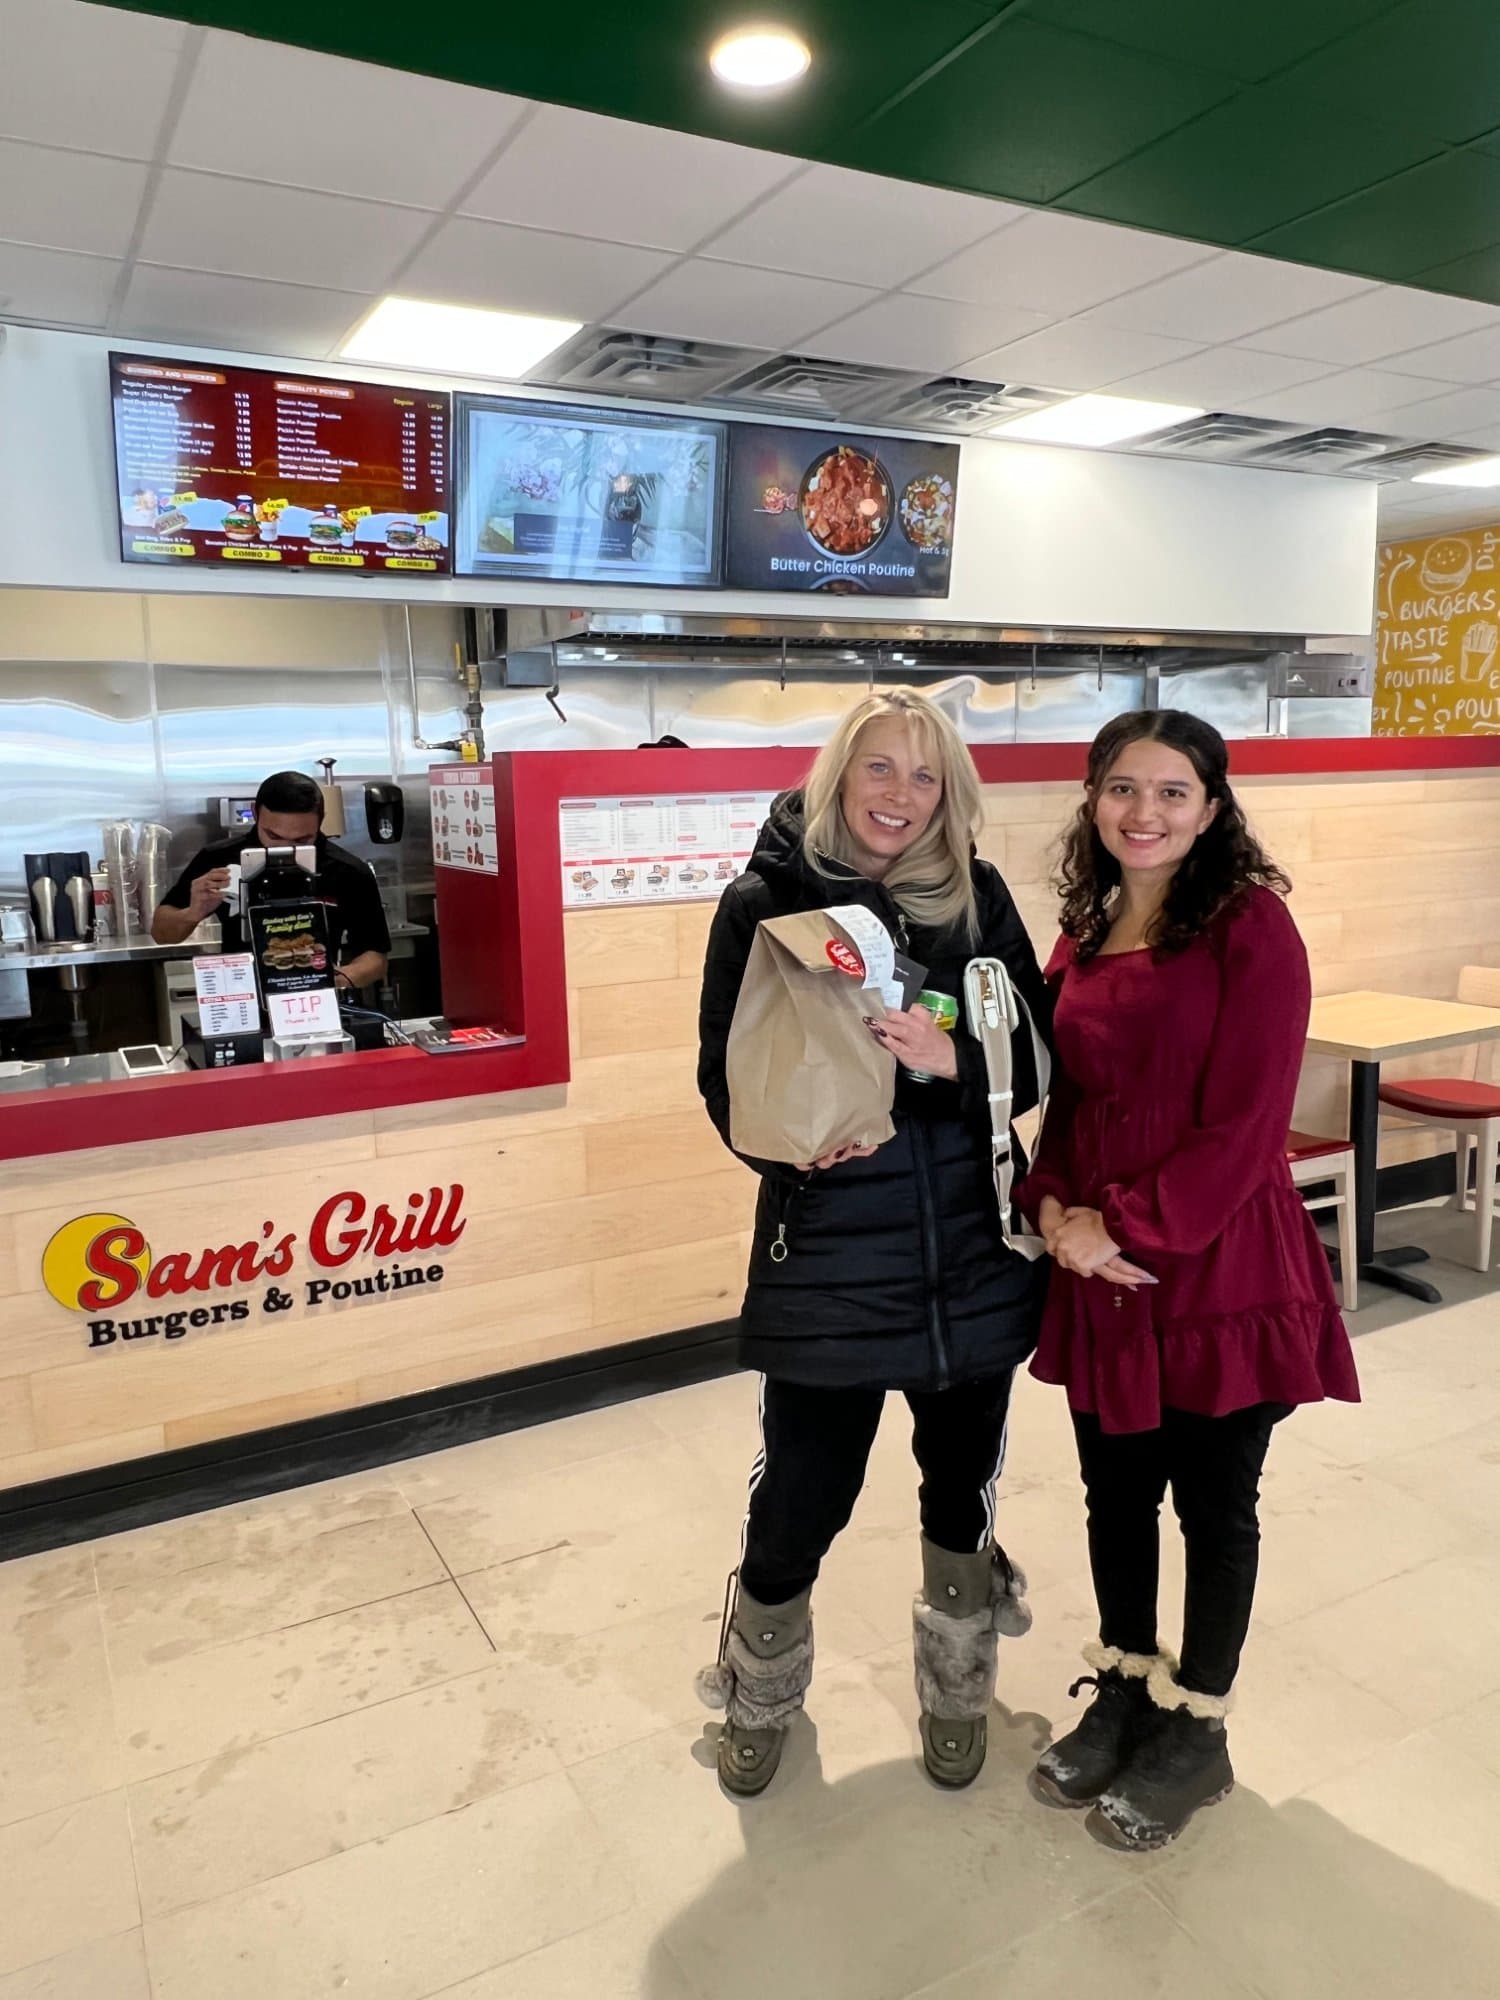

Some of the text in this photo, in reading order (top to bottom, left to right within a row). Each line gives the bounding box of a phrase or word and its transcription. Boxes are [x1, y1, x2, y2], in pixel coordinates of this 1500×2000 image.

[232, 550, 260, 559] COMBO
[317, 555, 346, 563] COMBO
[396, 560, 423, 568] COMBO
[770, 557, 916, 577] Butter Chicken Poutine
[1400, 589, 1496, 621] BURGERS
[1392, 626, 1449, 651] TASTE
[1384, 665, 1456, 689] POUTINE
[280, 995, 321, 1015] TIP
[77, 1183, 468, 1312] Sam's Grill
[87, 1264, 444, 1348] Burgers & Poutine
